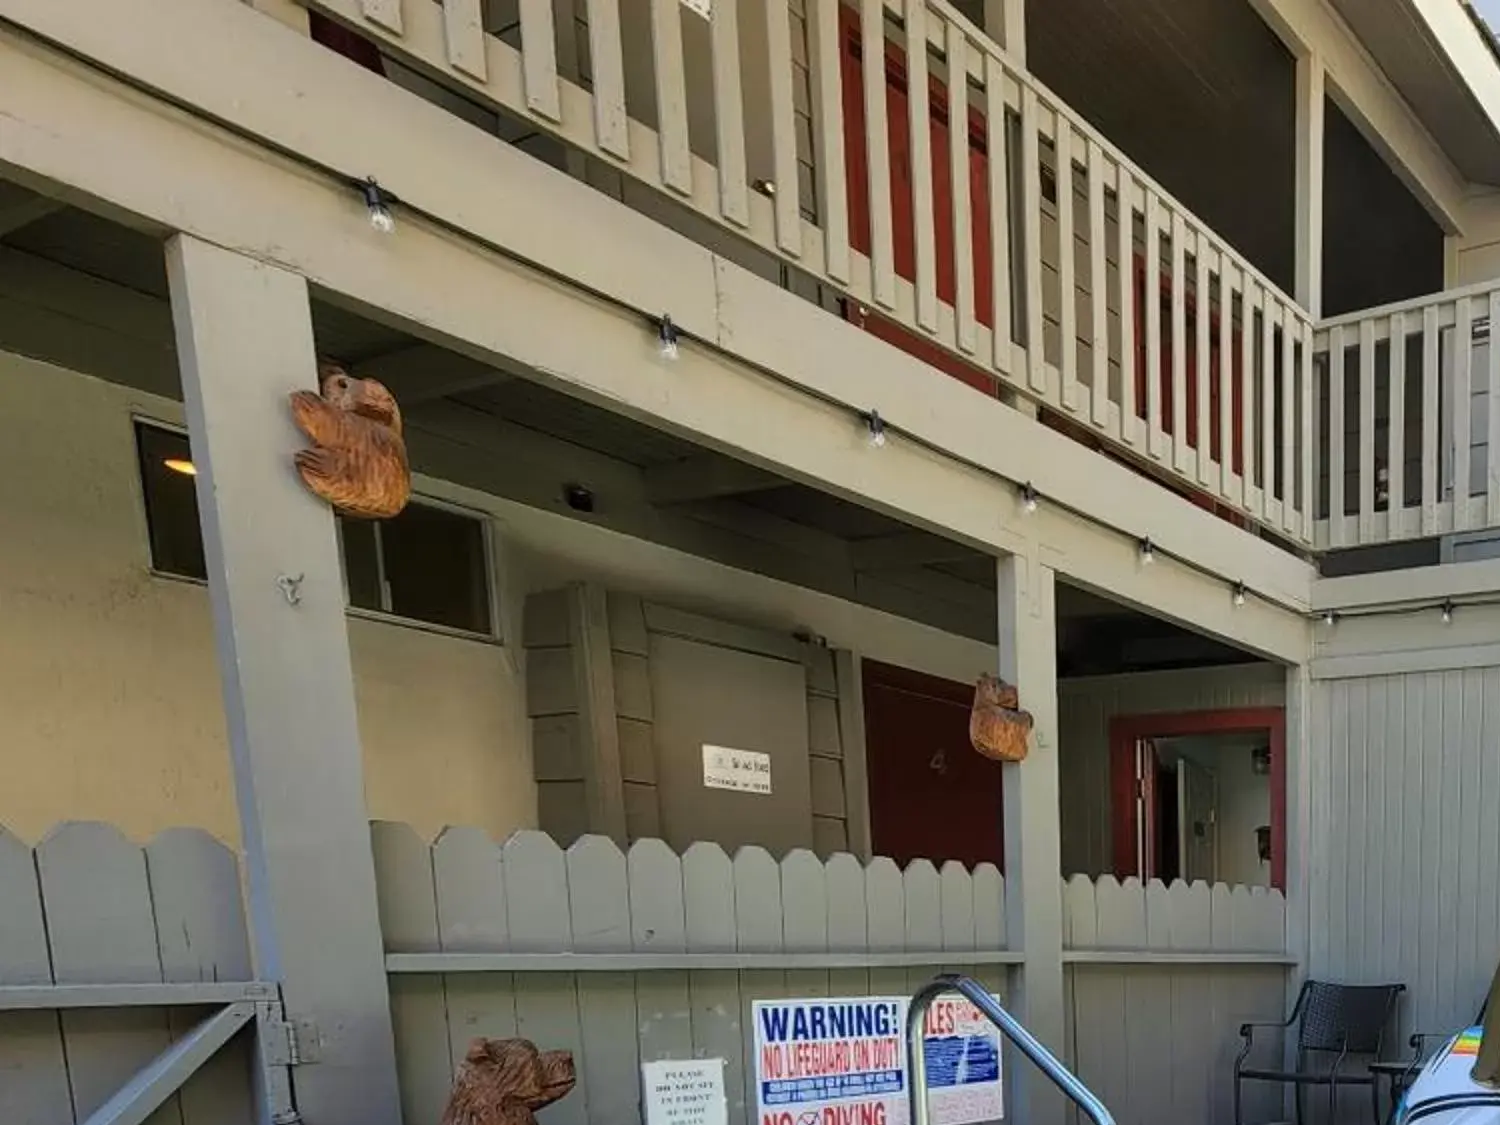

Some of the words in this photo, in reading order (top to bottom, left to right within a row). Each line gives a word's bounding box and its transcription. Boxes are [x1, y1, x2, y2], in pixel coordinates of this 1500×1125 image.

[929, 748, 947, 775] 4
[762, 1003, 898, 1042] WARNING!
[763, 1043, 783, 1078] NO
[786, 1040, 850, 1076] LIFEGUARD
[854, 1039, 870, 1070] ON
